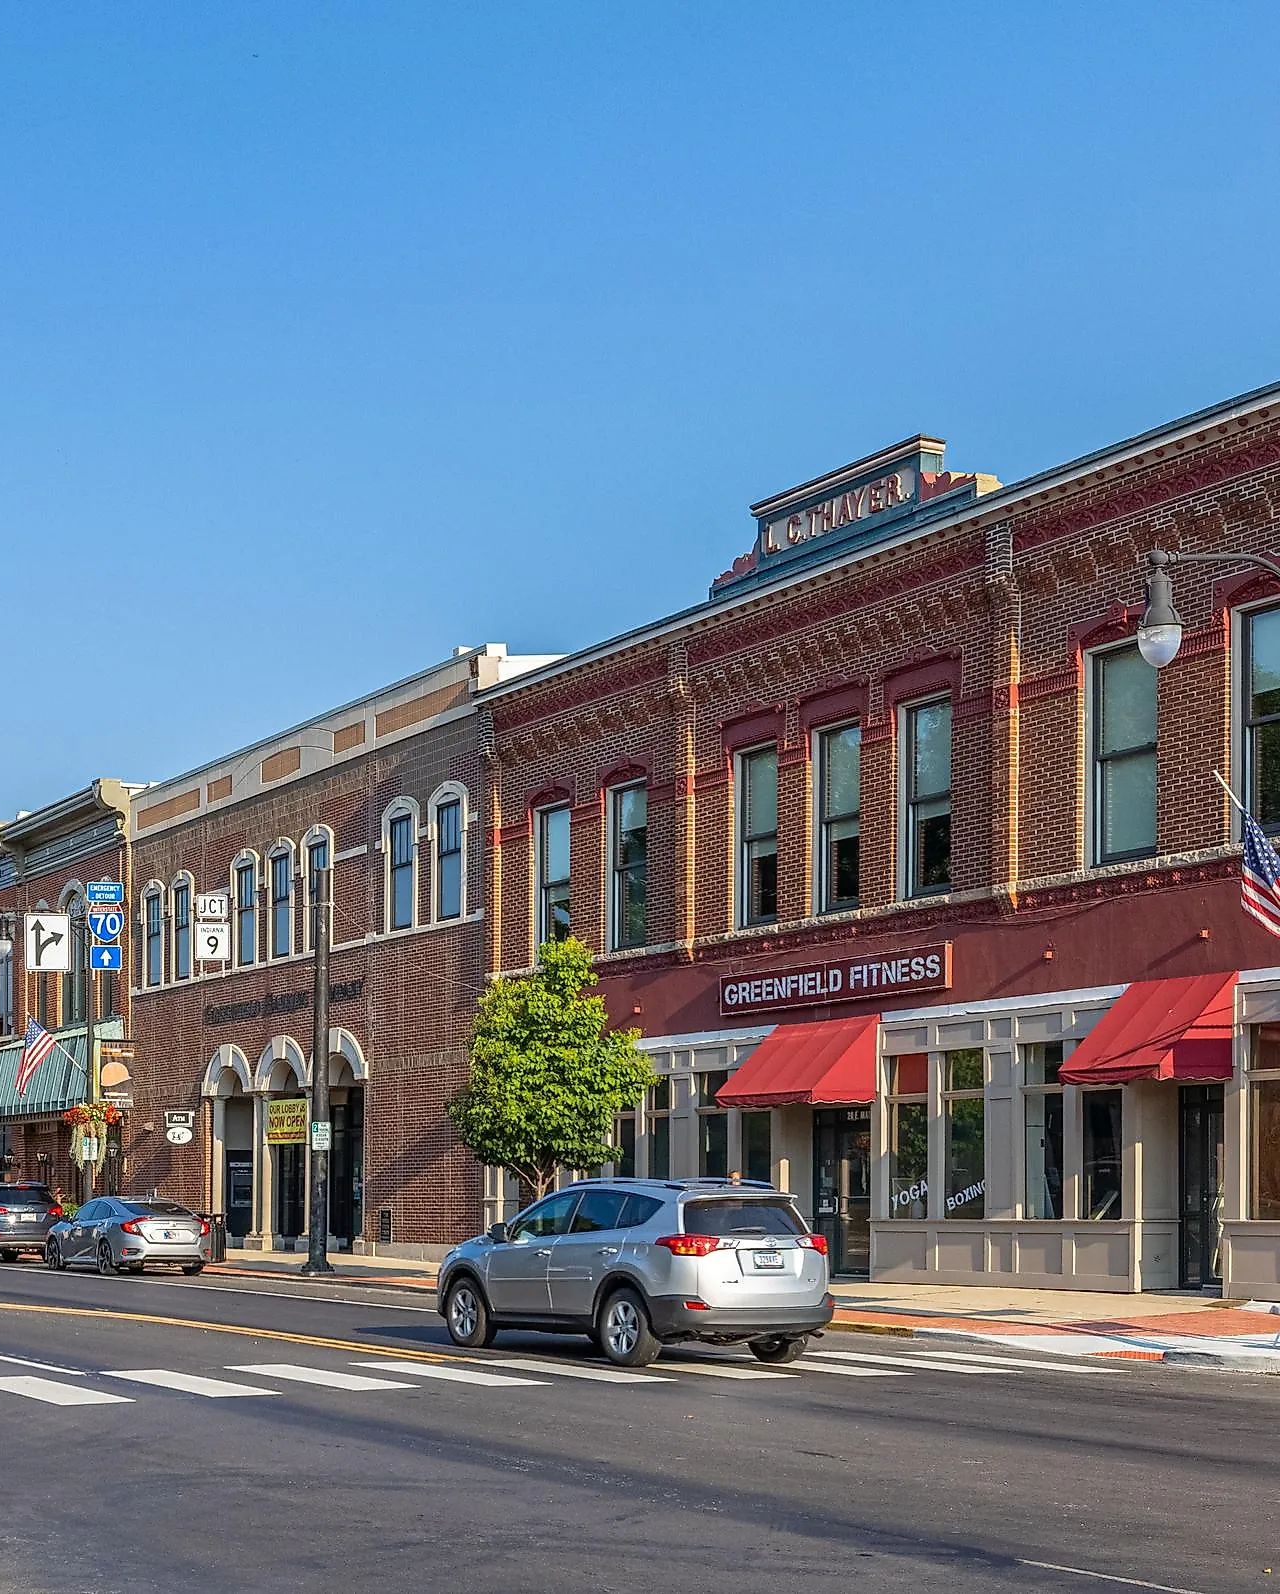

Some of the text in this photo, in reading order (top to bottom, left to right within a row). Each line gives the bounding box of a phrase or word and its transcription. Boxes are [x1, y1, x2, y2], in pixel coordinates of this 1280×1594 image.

[200, 898, 225, 914] JCT
[91, 913, 121, 935] 70
[206, 935, 219, 955] 9
[723, 954, 942, 1006] GREENFIELD FITNESS
[269, 1104, 281, 1115] OUR
[281, 1103, 299, 1114] LOBBY
[269, 1114, 306, 1129] NOW OPEN
[891, 1179, 929, 1211] YOGA
